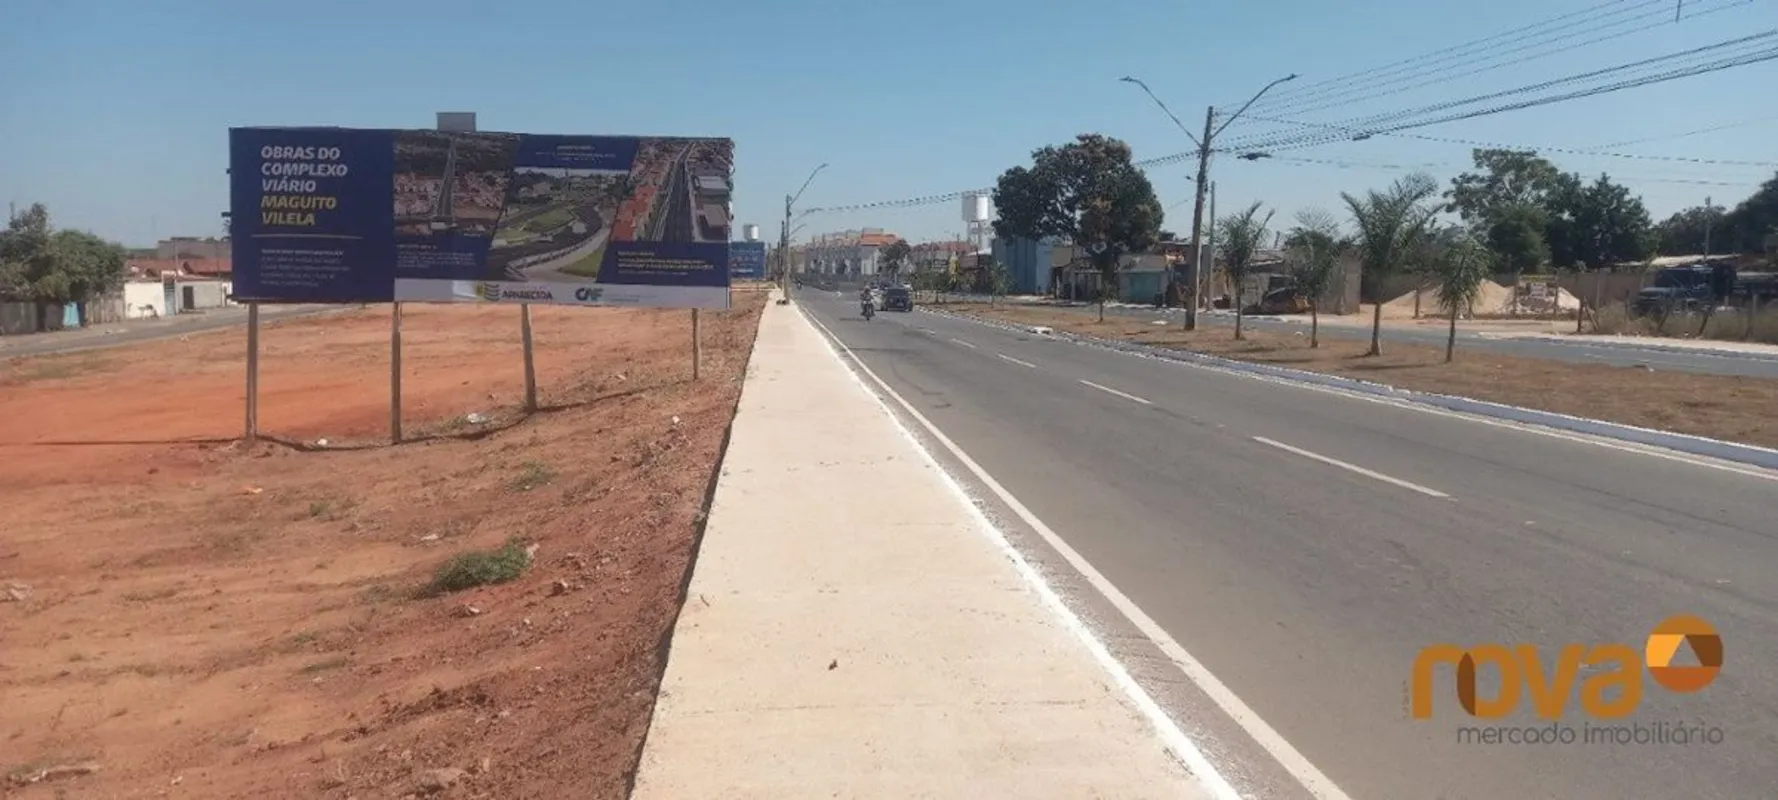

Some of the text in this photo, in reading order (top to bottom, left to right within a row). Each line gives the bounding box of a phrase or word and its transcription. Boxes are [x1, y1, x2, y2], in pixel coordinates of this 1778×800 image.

[261, 146, 341, 160] OBRAS DO
[261, 162, 348, 176] COMPLEXO
[261, 177, 316, 193] VIÁRIO
[261, 195, 337, 210] MAGUITO
[261, 211, 316, 226] VILELA
[502, 289, 554, 301] APARECIDA
